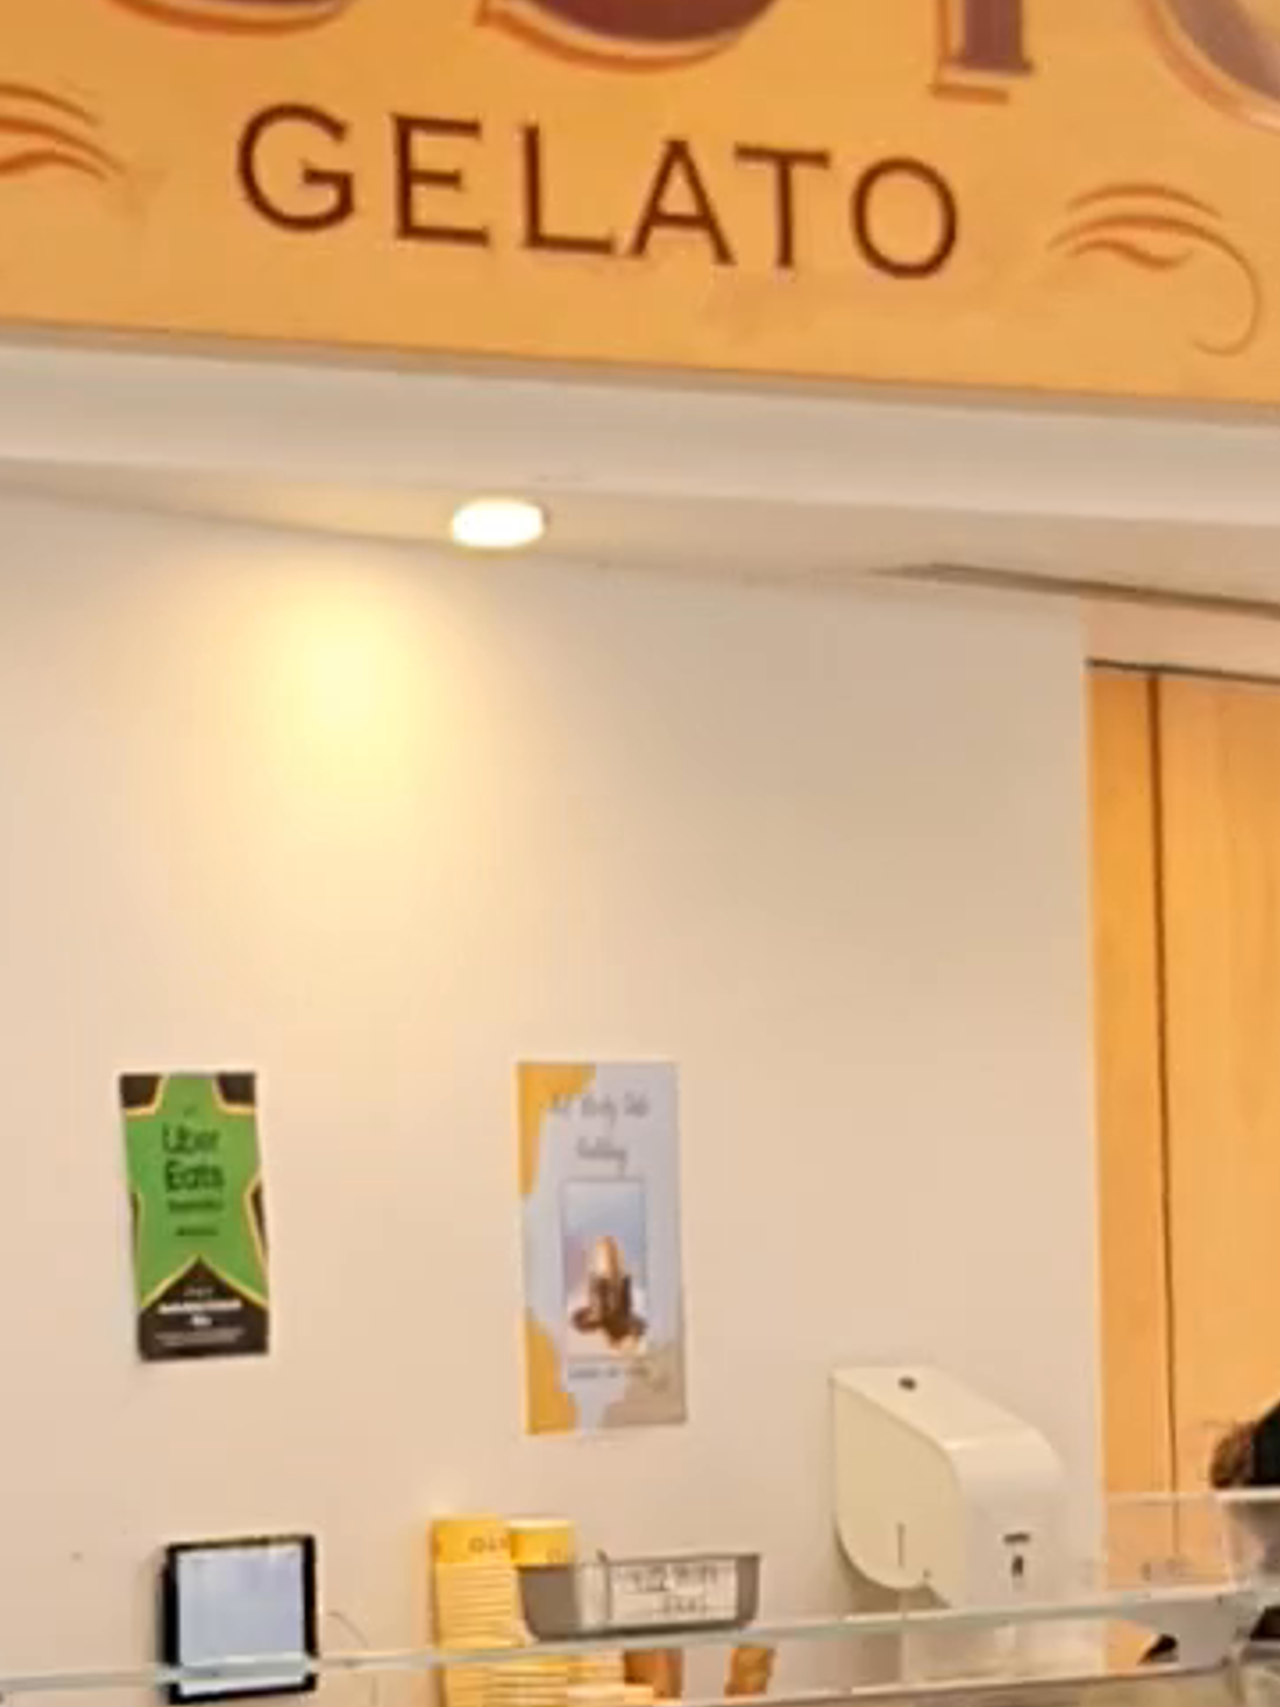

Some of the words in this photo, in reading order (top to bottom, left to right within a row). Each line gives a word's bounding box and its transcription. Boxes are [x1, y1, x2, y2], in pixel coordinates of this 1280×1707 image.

[236, 103, 960, 280] GELATO
[162, 1122, 221, 1154] Uber
[165, 1159, 226, 1193] Eats
